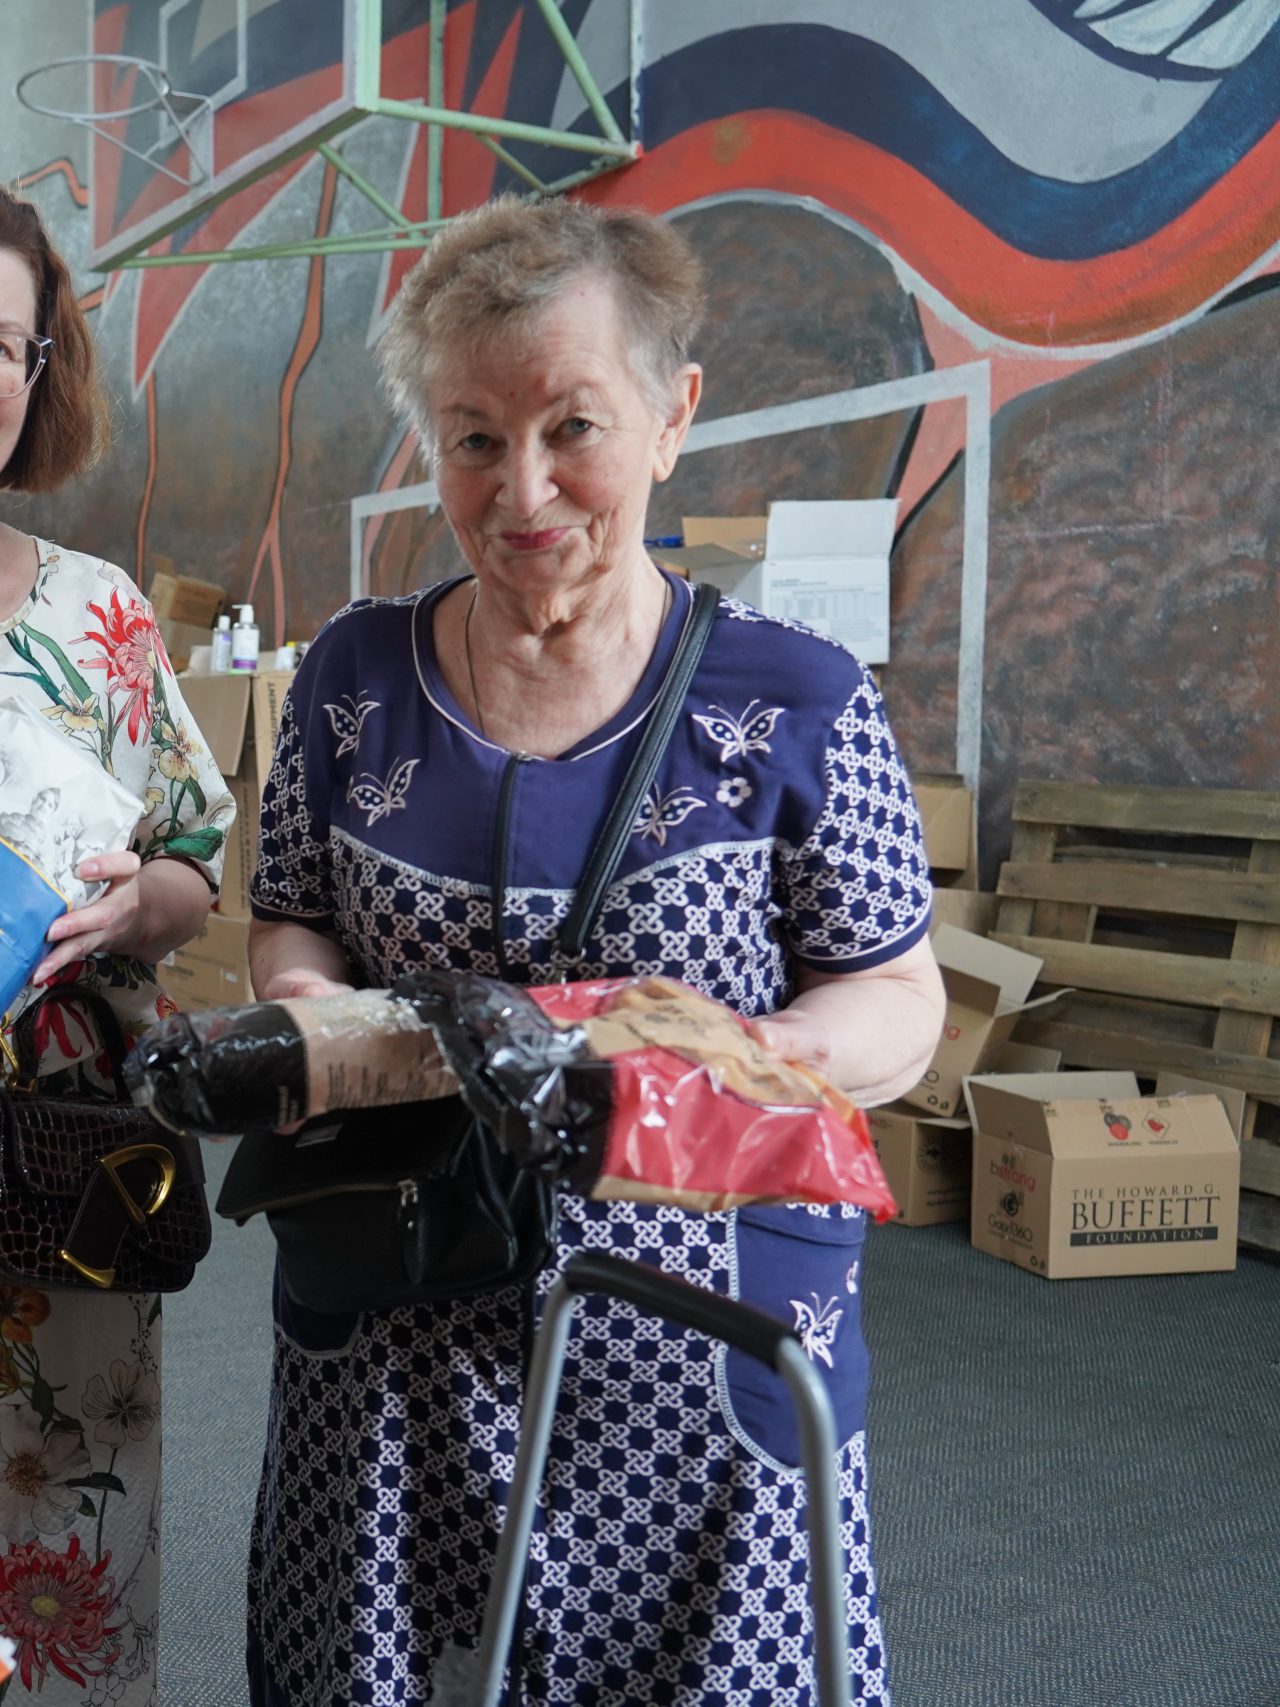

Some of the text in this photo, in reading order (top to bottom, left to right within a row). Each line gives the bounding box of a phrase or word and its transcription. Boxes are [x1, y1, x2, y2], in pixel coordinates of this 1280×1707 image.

[1072, 1183, 1220, 1200] THE HOWARD G.
[1071, 1196, 1221, 1231] BUFFETT
[987, 1213, 1033, 1243] Good360
[1086, 1229, 1205, 1245] FOUNDATION
